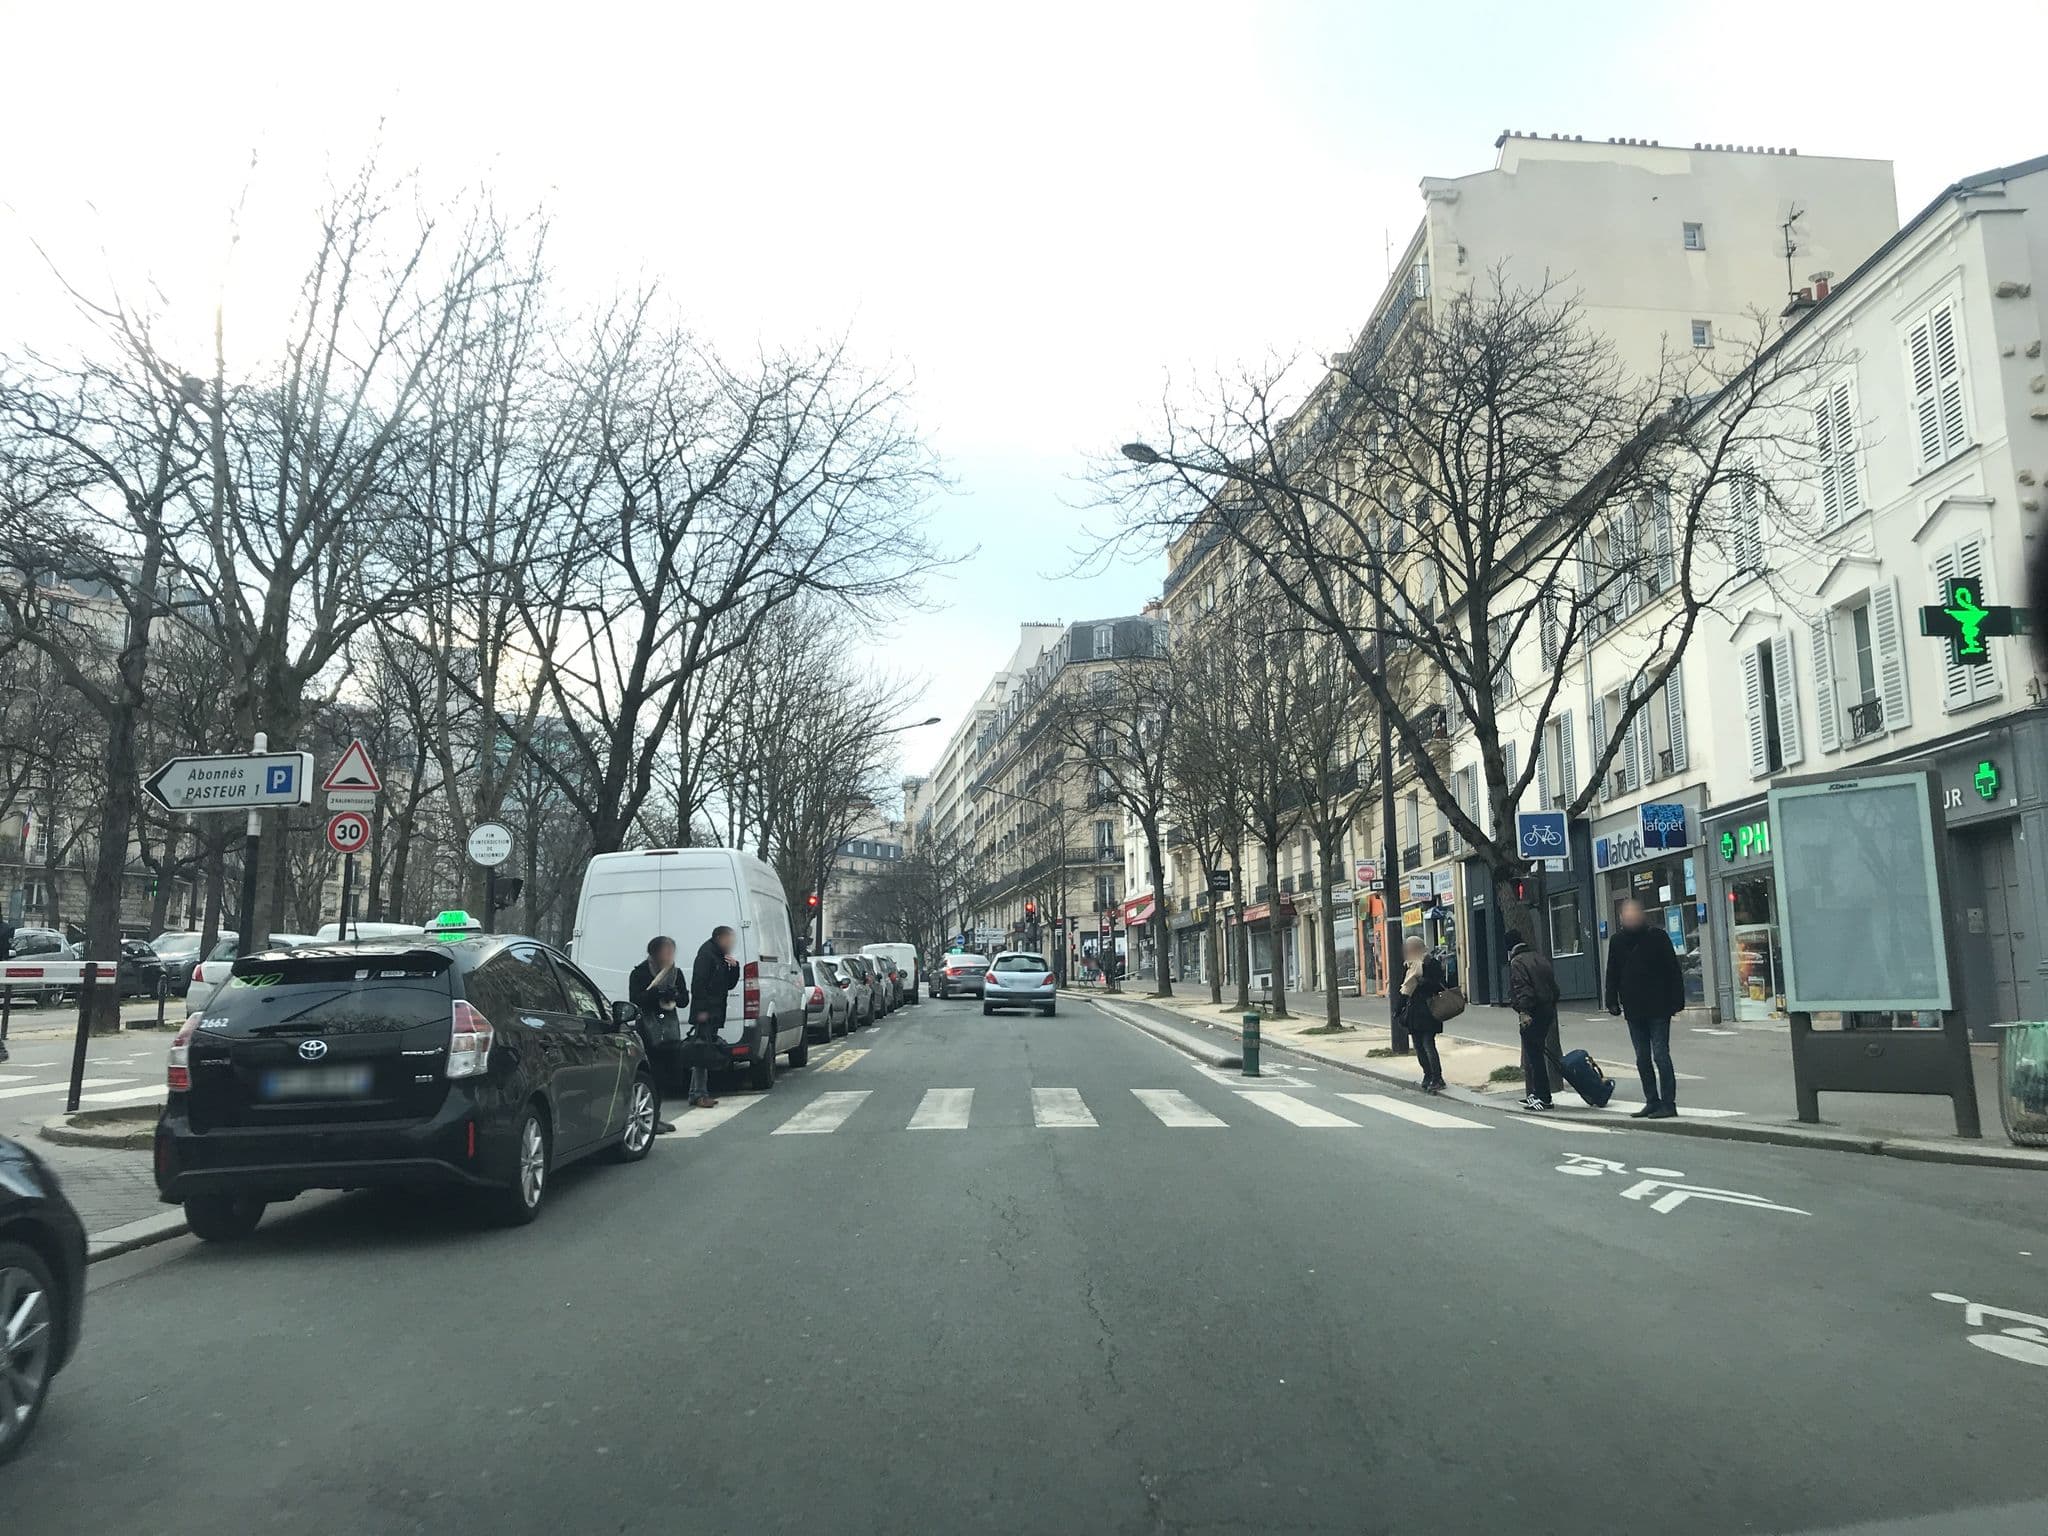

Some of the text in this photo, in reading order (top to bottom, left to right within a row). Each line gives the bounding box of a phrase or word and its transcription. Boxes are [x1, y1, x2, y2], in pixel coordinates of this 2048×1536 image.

[188, 767, 244, 781] Abonnés
[186, 784, 260, 799] PASTEUR 1
[337, 824, 360, 840] 30
[1644, 818, 1683, 832] laforêt
[1607, 831, 1647, 866] laforêt
[200, 1018, 229, 1029] 2662
